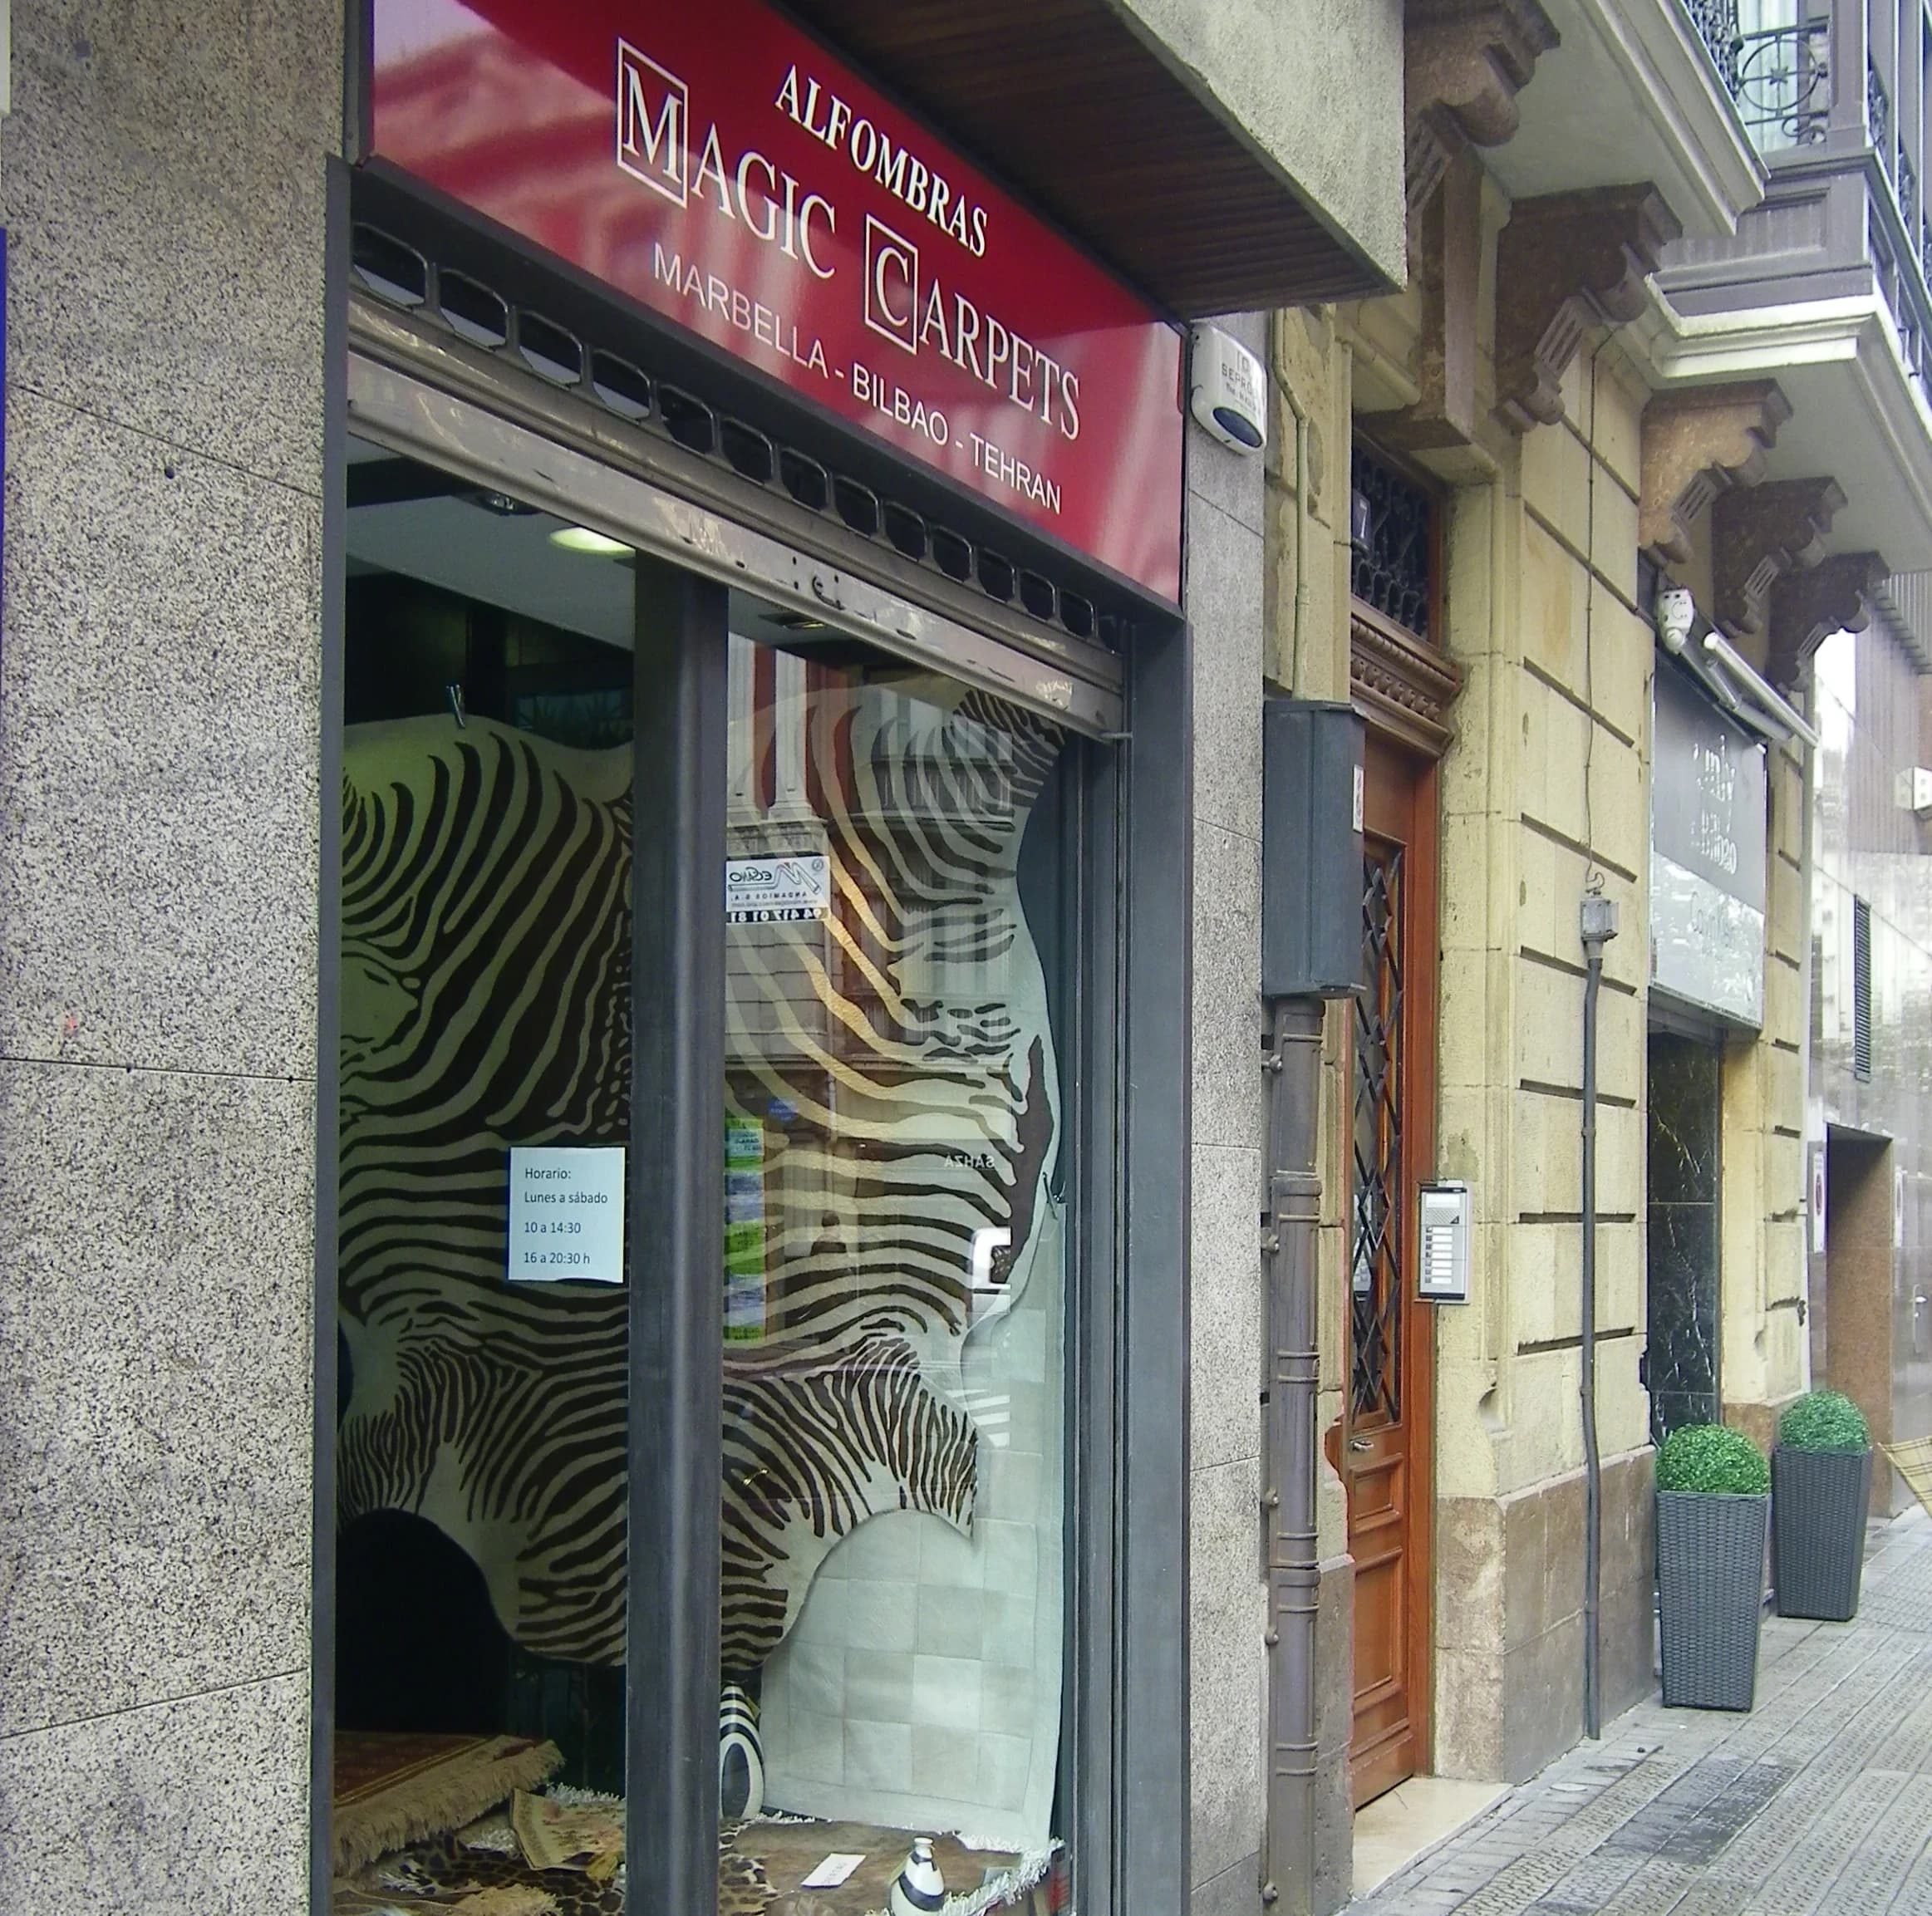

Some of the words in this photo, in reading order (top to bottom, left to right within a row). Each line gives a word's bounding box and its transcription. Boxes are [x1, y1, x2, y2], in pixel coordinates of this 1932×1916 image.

[774, 64, 988, 258] ALFOMBRAS
[622, 61, 836, 279] MAGIC
[874, 245, 1080, 442] CARPETS
[653, 242, 829, 379] MARBELLA
[853, 361, 948, 446] BILBAO
[971, 431, 1061, 514] TEHRAN
[524, 1167, 571, 1180] Horario:
[524, 1191, 556, 1203] Lunes
[559, 1194, 566, 1203] a
[568, 1191, 608, 1203] sábado
[524, 1221, 538, 1233] 10
[540, 1224, 547, 1233] a
[551, 1221, 581, 1234] 14:30
[524, 1252, 537, 1264] 16
[540, 1255, 546, 1264] a
[549, 1252, 580, 1265] 20:30
[583, 1253, 590, 1264] h
